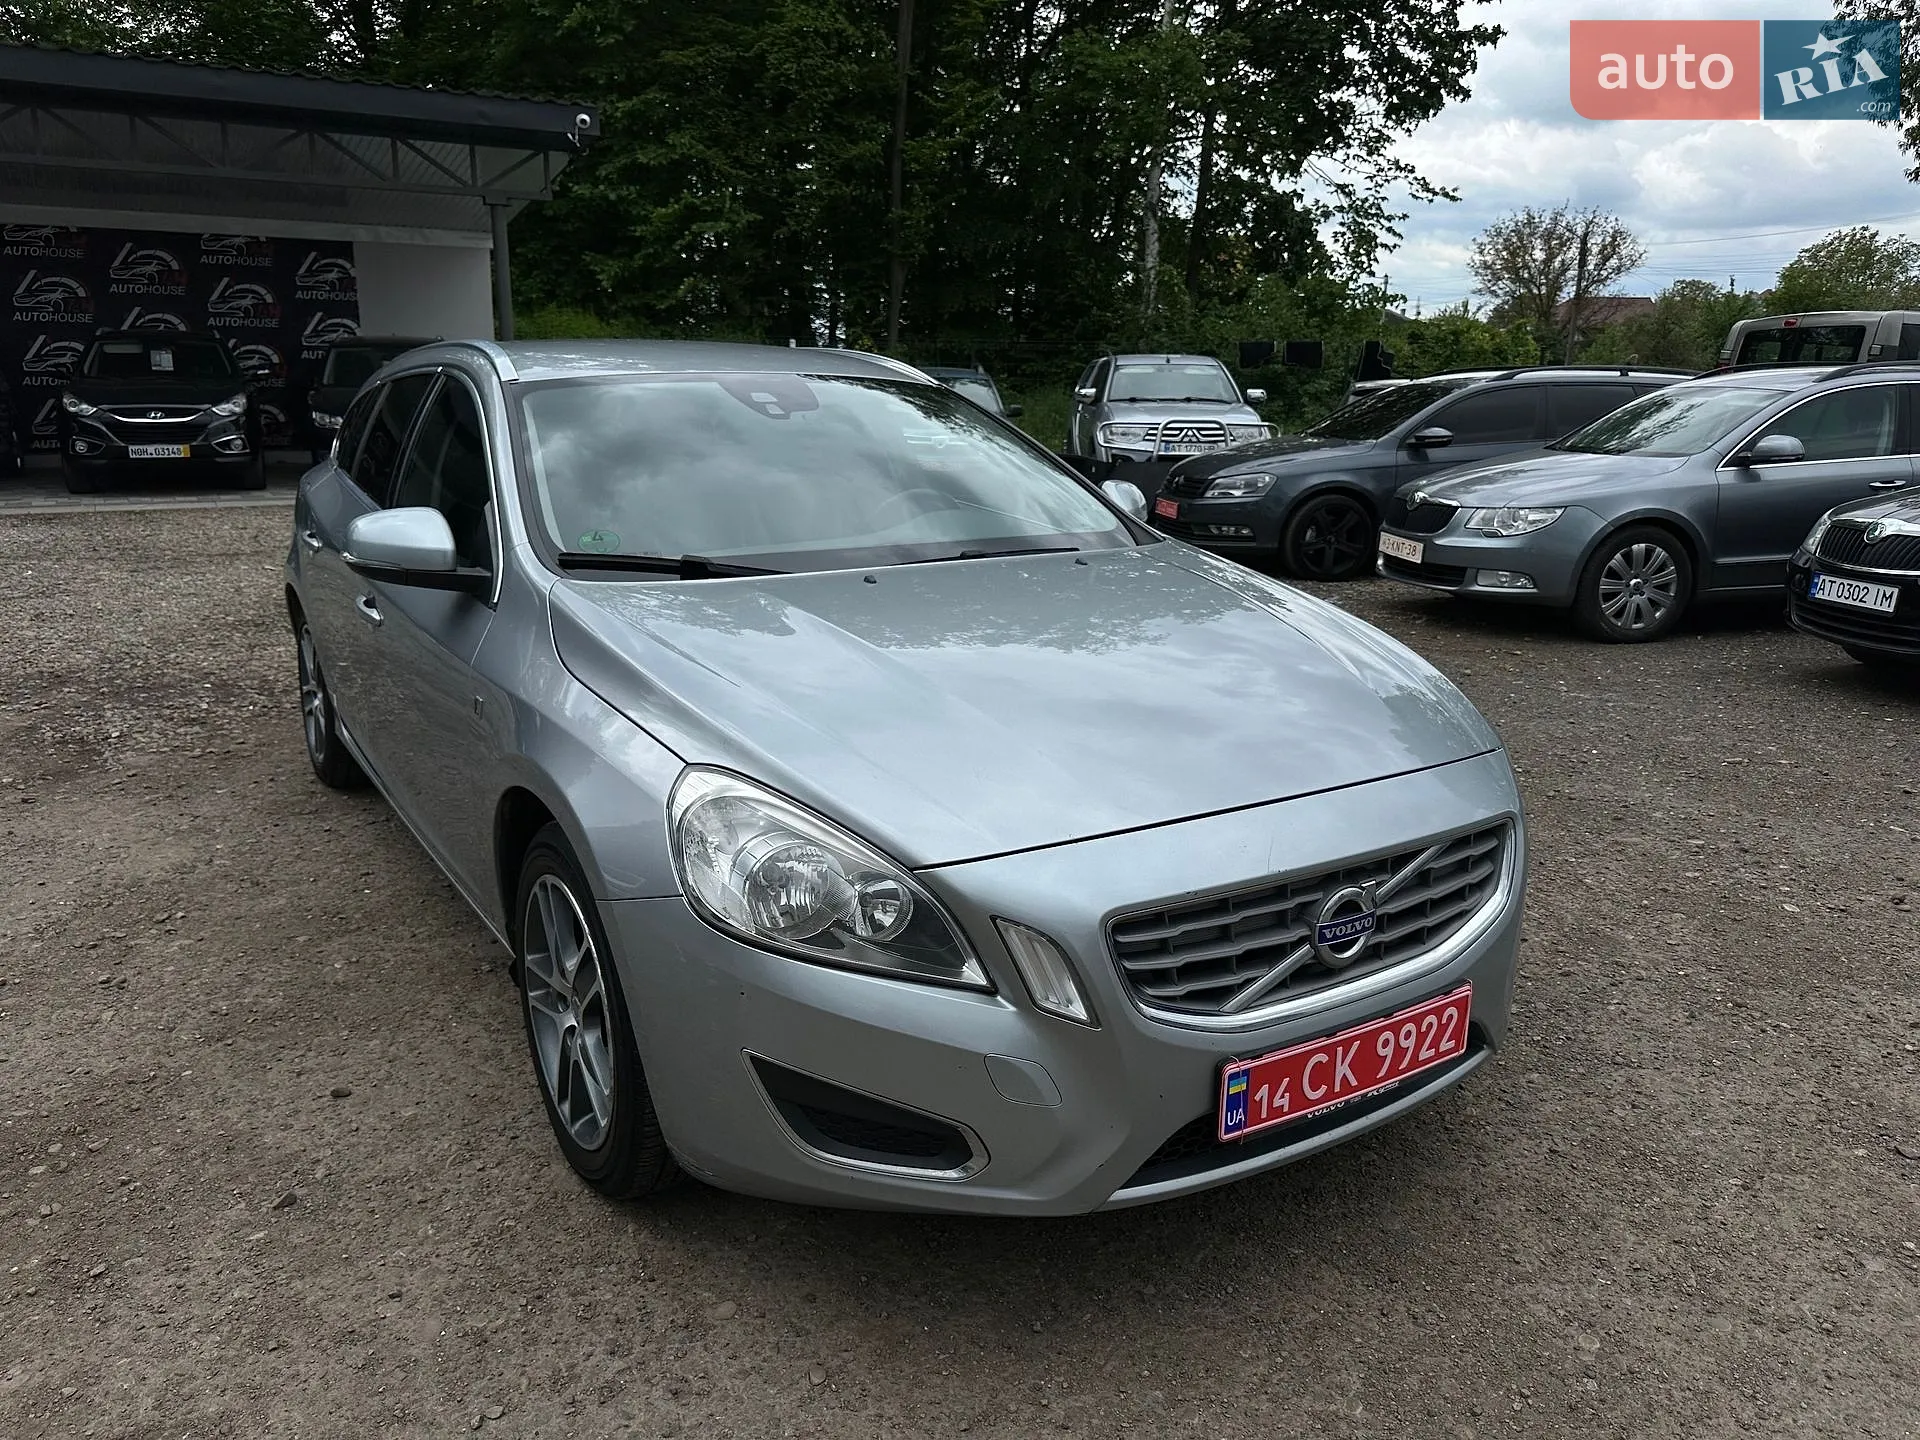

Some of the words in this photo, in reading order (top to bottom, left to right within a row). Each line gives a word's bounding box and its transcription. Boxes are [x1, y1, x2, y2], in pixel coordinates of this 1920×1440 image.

[3, 246, 86, 258] AUTOHOUSE
[200, 255, 273, 267] AUTOHOUSE
[109, 284, 187, 296] AUTOHOUSE
[295, 290, 358, 301] AUTOHOUS
[13, 312, 95, 323] AUTOHOUSE
[207, 317, 280, 328] AUTOHOUSE
[1816, 579, 1836, 596] AT
[1836, 582, 1869, 603] 0302
[1873, 588, 1894, 608] IM
[1322, 917, 1373, 939] VOLVO
[1254, 1077, 1290, 1119] 14
[1302, 1040, 1361, 1100] CK
[1376, 1006, 1459, 1079] 9922
[1227, 1107, 1245, 1126] UA
